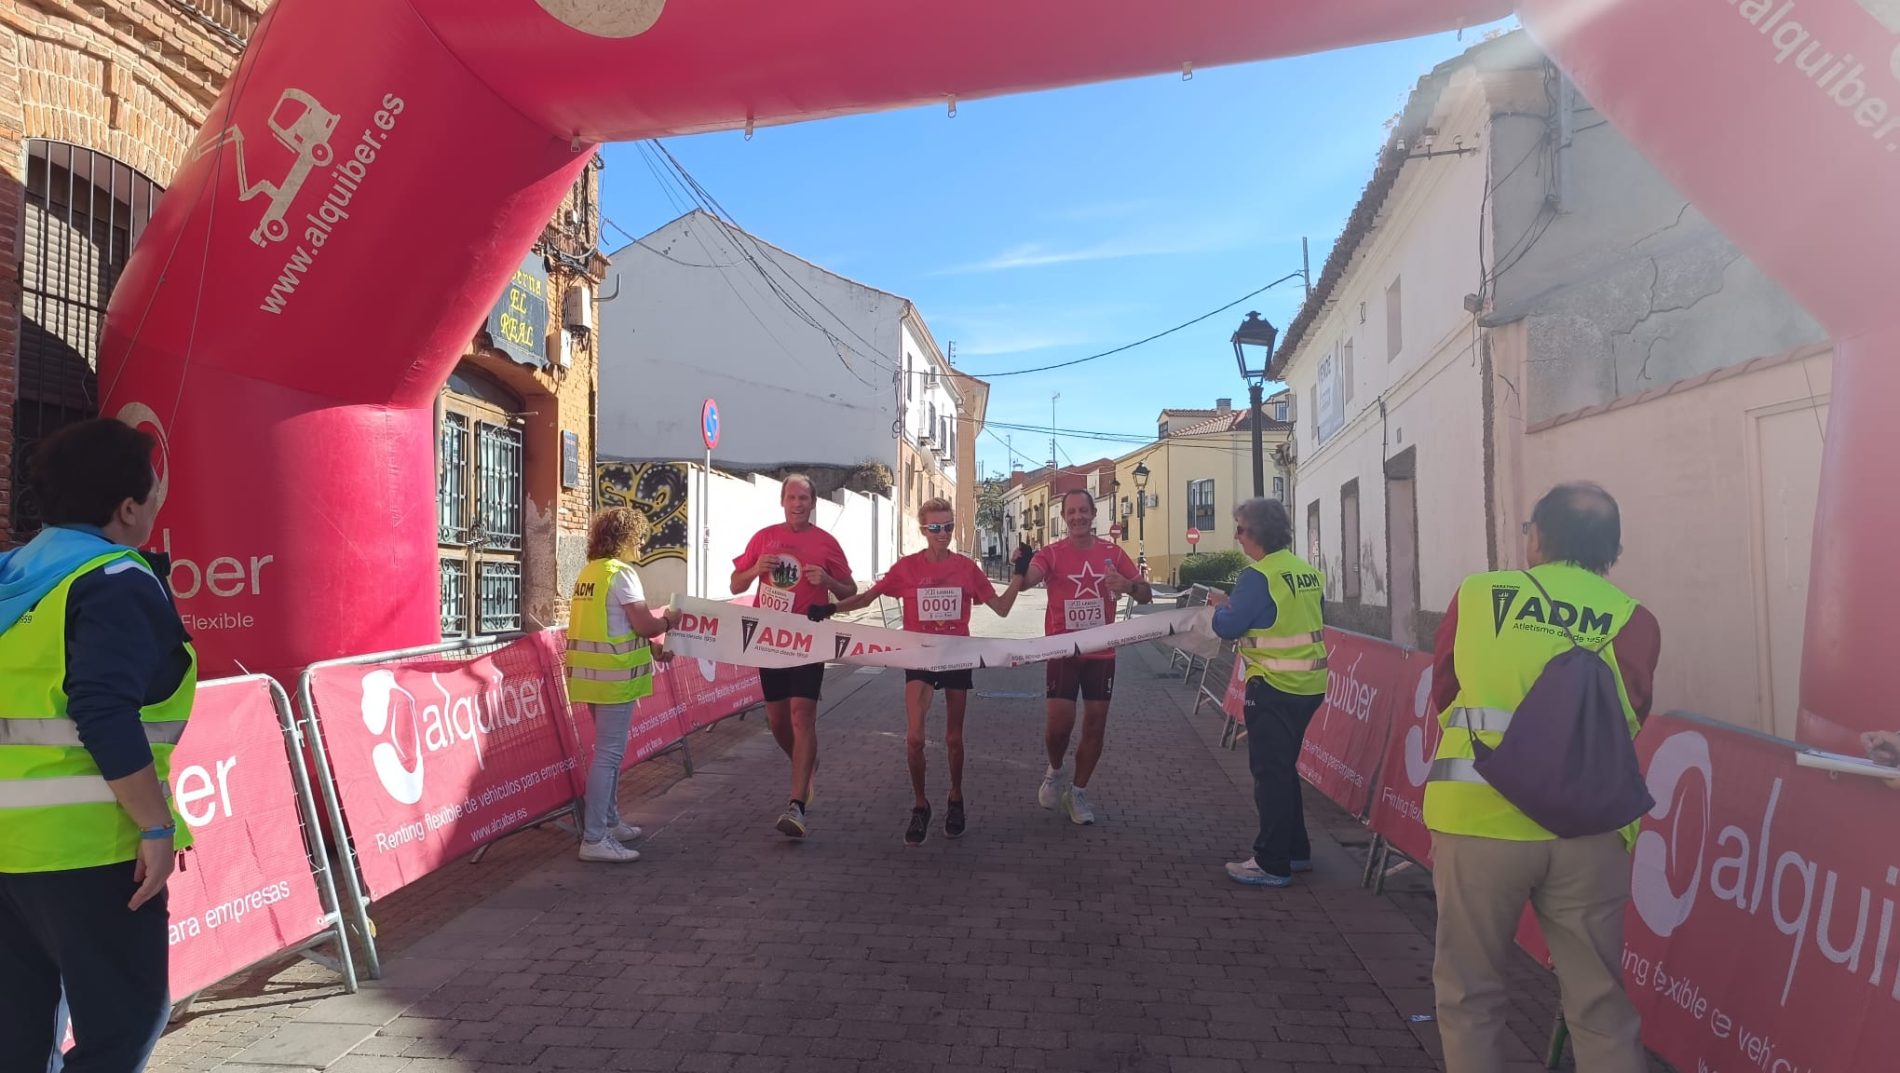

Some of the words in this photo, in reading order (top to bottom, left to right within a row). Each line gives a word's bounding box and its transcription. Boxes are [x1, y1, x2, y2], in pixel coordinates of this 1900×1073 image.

[260, 93, 405, 314] www.alquiber.es
[501, 312, 533, 346] REAL
[1296, 573, 1320, 588] ADM
[761, 593, 789, 613] 0002
[923, 599, 957, 612] 0001
[1069, 608, 1102, 621] 0073
[1515, 597, 1613, 635] ADM
[181, 612, 255, 631] Flexible
[672, 613, 719, 636] DM
[1513, 622, 1555, 635] Atletismo
[1557, 629, 1584, 643] dede
[757, 626, 814, 653] ADM
[1325, 645, 1377, 730] quiber
[422, 656, 546, 771] alquiber
[376, 820, 426, 854] Renting
[424, 803, 464, 832] flexible
[464, 796, 478, 814] de
[520, 771, 541, 793] para
[470, 806, 527, 842] www.alquiber.es
[169, 916, 201, 945] ara
[205, 880, 290, 928] empresas
